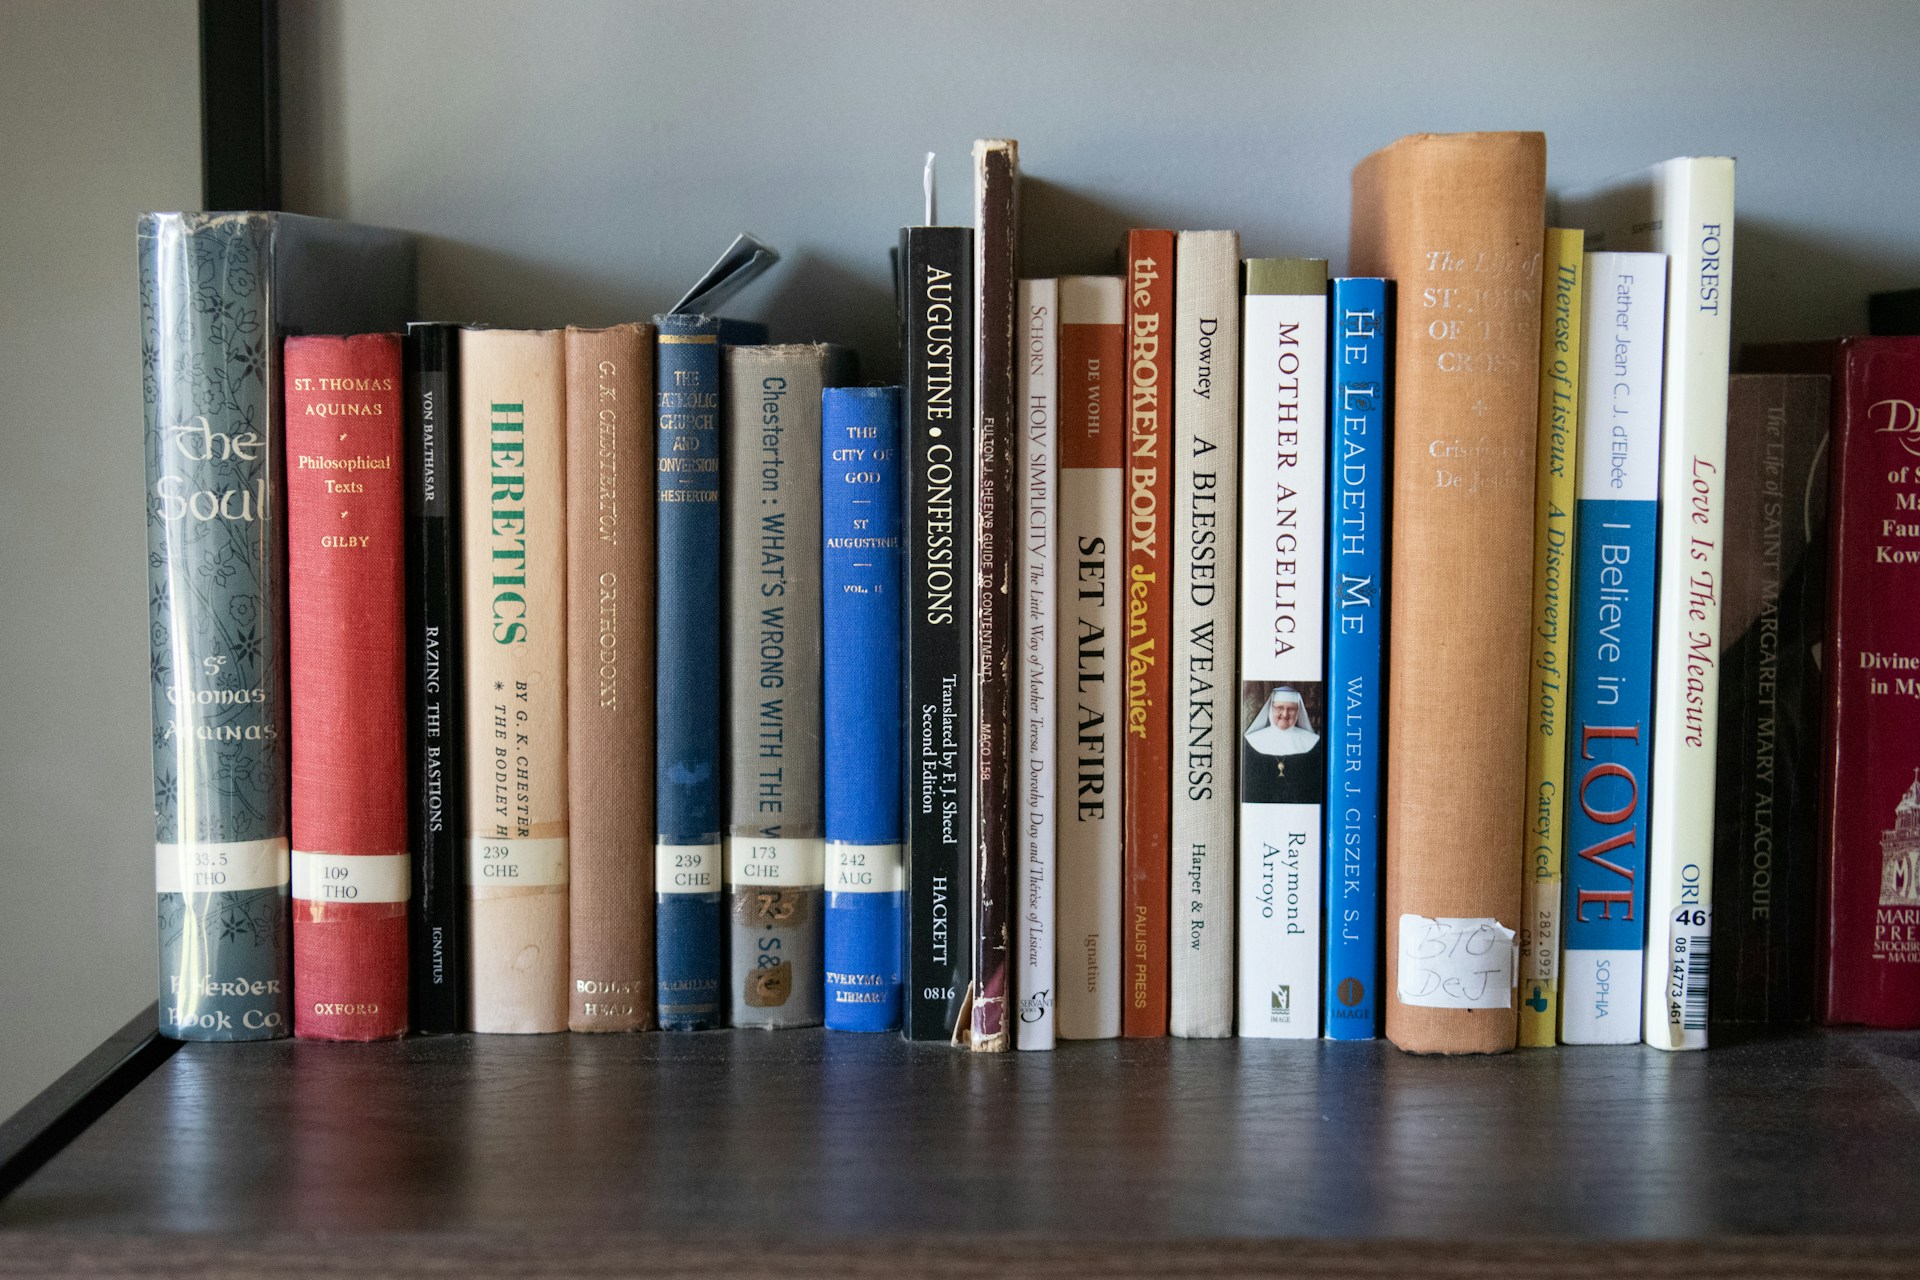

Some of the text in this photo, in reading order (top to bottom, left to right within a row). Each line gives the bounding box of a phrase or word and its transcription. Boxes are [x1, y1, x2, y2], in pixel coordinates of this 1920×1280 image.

[1426, 251, 1465, 271] The
[1428, 319, 1463, 339] OF
[295, 378, 391, 391] ST. THOMAS
[674, 371, 699, 386] THE
[1610, 274, 1634, 489] Father Jean C. J. d'Elbée
[305, 403, 382, 416] AQUINAS
[1087, 358, 1101, 438] DE WOHL
[660, 415, 714, 429] CHURCH
[846, 427, 877, 438] THE
[423, 391, 435, 501] VON BALTHASAR
[673, 436, 700, 451] AND
[832, 449, 865, 460] CITY
[926, 265, 953, 625] AUGUSTINE CONFESSIONS
[299, 455, 390, 472] Philosophical
[845, 472, 881, 483] GOD
[1888, 466, 1909, 483] of
[156, 475, 272, 521] Soul
[324, 480, 363, 493] Texts
[1129, 257, 1159, 738] the BROKEN BODY Jean Vanier
[1274, 321, 1300, 658] MOTHER ANGELICA
[1685, 223, 1721, 748] FOREST Love Is The Measure
[490, 400, 527, 645] HERETICS
[599, 360, 617, 711] G. K. CHESTERTON ORTHODOXY
[853, 519, 869, 529] ST
[321, 536, 369, 548] GILBY
[827, 538, 897, 548] AUGUSTINE
[1533, 263, 1577, 840] Therese of Lisieux A Discovery of Love Carey
[1188, 317, 1218, 802] Downey A BLESSED WEAKNESS
[982, 417, 994, 780] FULTON J. SHEEN'S GUIDE TO 158
[759, 513, 787, 813] WHAT'S WRONG WITH THE
[1751, 405, 1786, 920] The Life of SAINT MARGARET MARY ALACOQUE
[1859, 652, 1920, 669] Divine
[1027, 395, 1047, 967] HOLY SIMPLICITY The Little Way of Mother Teresa, Dorothy Day and Thérèse of Lisieux
[1078, 536, 1106, 822] SET ALL AFIRE
[1870, 678, 1888, 694] in
[426, 627, 442, 831] RAZING THE BASTIONS
[516, 681, 528, 751] BY G. K.
[1576, 544, 1640, 922] Believe in LOVE
[494, 704, 507, 819] THE BODLEY
[922, 704, 937, 814] Second Edition
[938, 674, 957, 844] Translated by F. J. Sheed
[1342, 676, 1363, 945] WALTER J. CISZEK, S.J.
[483, 847, 509, 859] 239
[675, 855, 701, 867] 239
[752, 847, 776, 859] 173
[841, 854, 866, 866] 242
[194, 872, 226, 884] THO
[324, 866, 349, 880] 109
[483, 864, 518, 877] CHE
[674, 873, 711, 886] CHE
[744, 864, 779, 877] CHE
[838, 872, 872, 885] AUG
[1256, 843, 1280, 918] Arroyo
[1281, 832, 1306, 934] Raymond
[323, 884, 358, 899] THO
[1189, 843, 1206, 950] Harper & Row
[933, 876, 948, 965] HACKETT
[431, 927, 443, 984] IGNATIUS
[1135, 906, 1147, 1008] PAULIST PRESS
[1406, 923, 1496, 960] BIO
[1520, 929, 1531, 957] CAR
[1538, 911, 1551, 977] 282.092
[1084, 934, 1100, 992] Ignatius
[836, 991, 888, 1002] LIBRARY
[924, 987, 955, 999] 0816
[1595, 960, 1610, 1019] SOPHIA
[1671, 937, 1686, 1025] 08 14773 461
[243, 1010, 282, 1028] Co.
[314, 1003, 378, 1016] OXFORD
[1332, 1008, 1370, 1018] IMAGE
